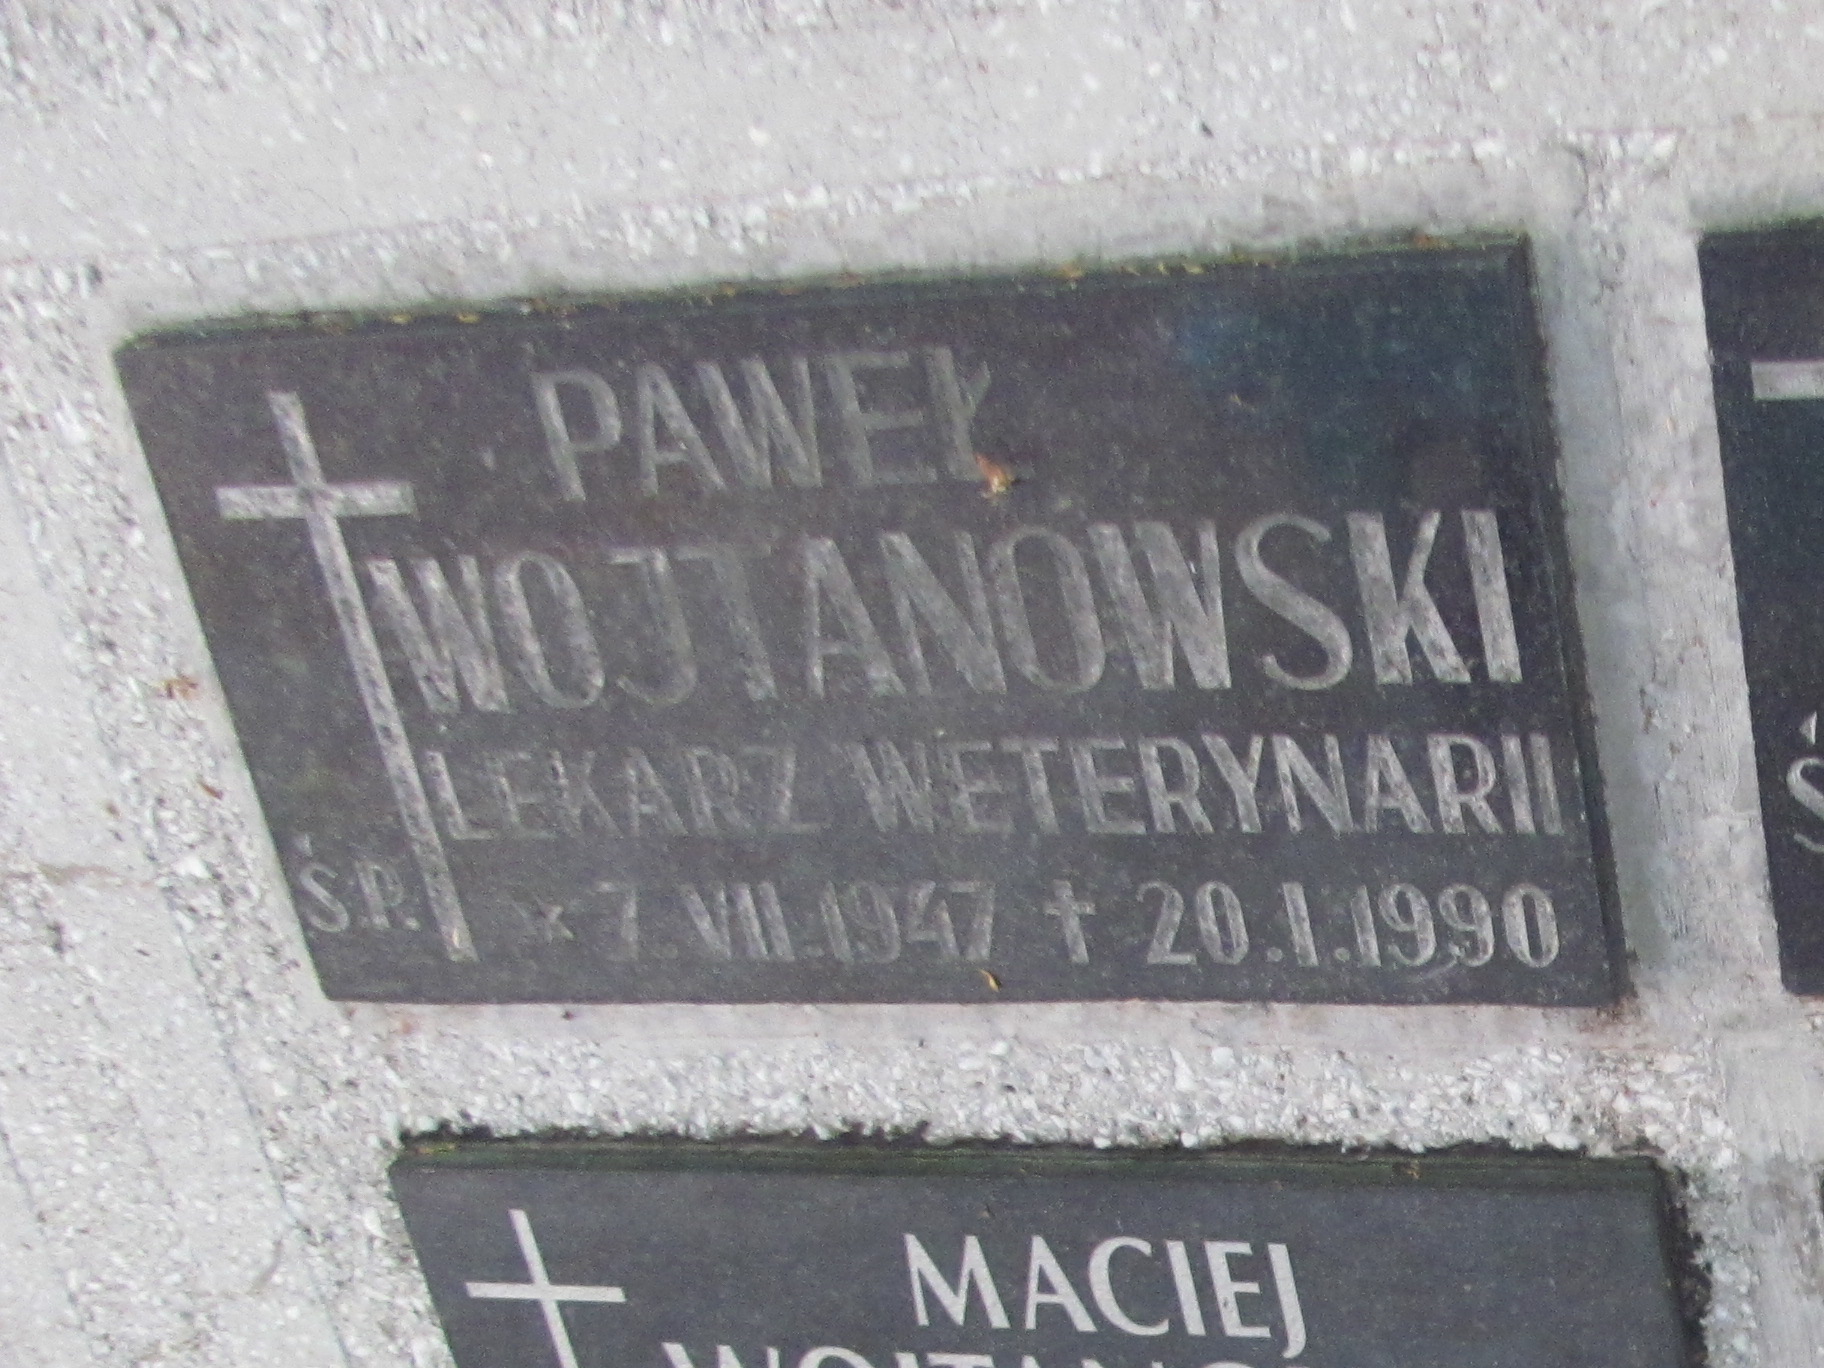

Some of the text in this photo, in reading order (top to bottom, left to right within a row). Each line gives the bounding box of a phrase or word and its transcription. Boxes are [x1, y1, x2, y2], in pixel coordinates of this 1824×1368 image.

[366, 508, 1523, 714] WOJTANOWSKI
[424, 745, 823, 840] LEKARZ
[847, 732, 1565, 836] WETERYNARII
[904, 1233, 1307, 1358] MACIEJ
